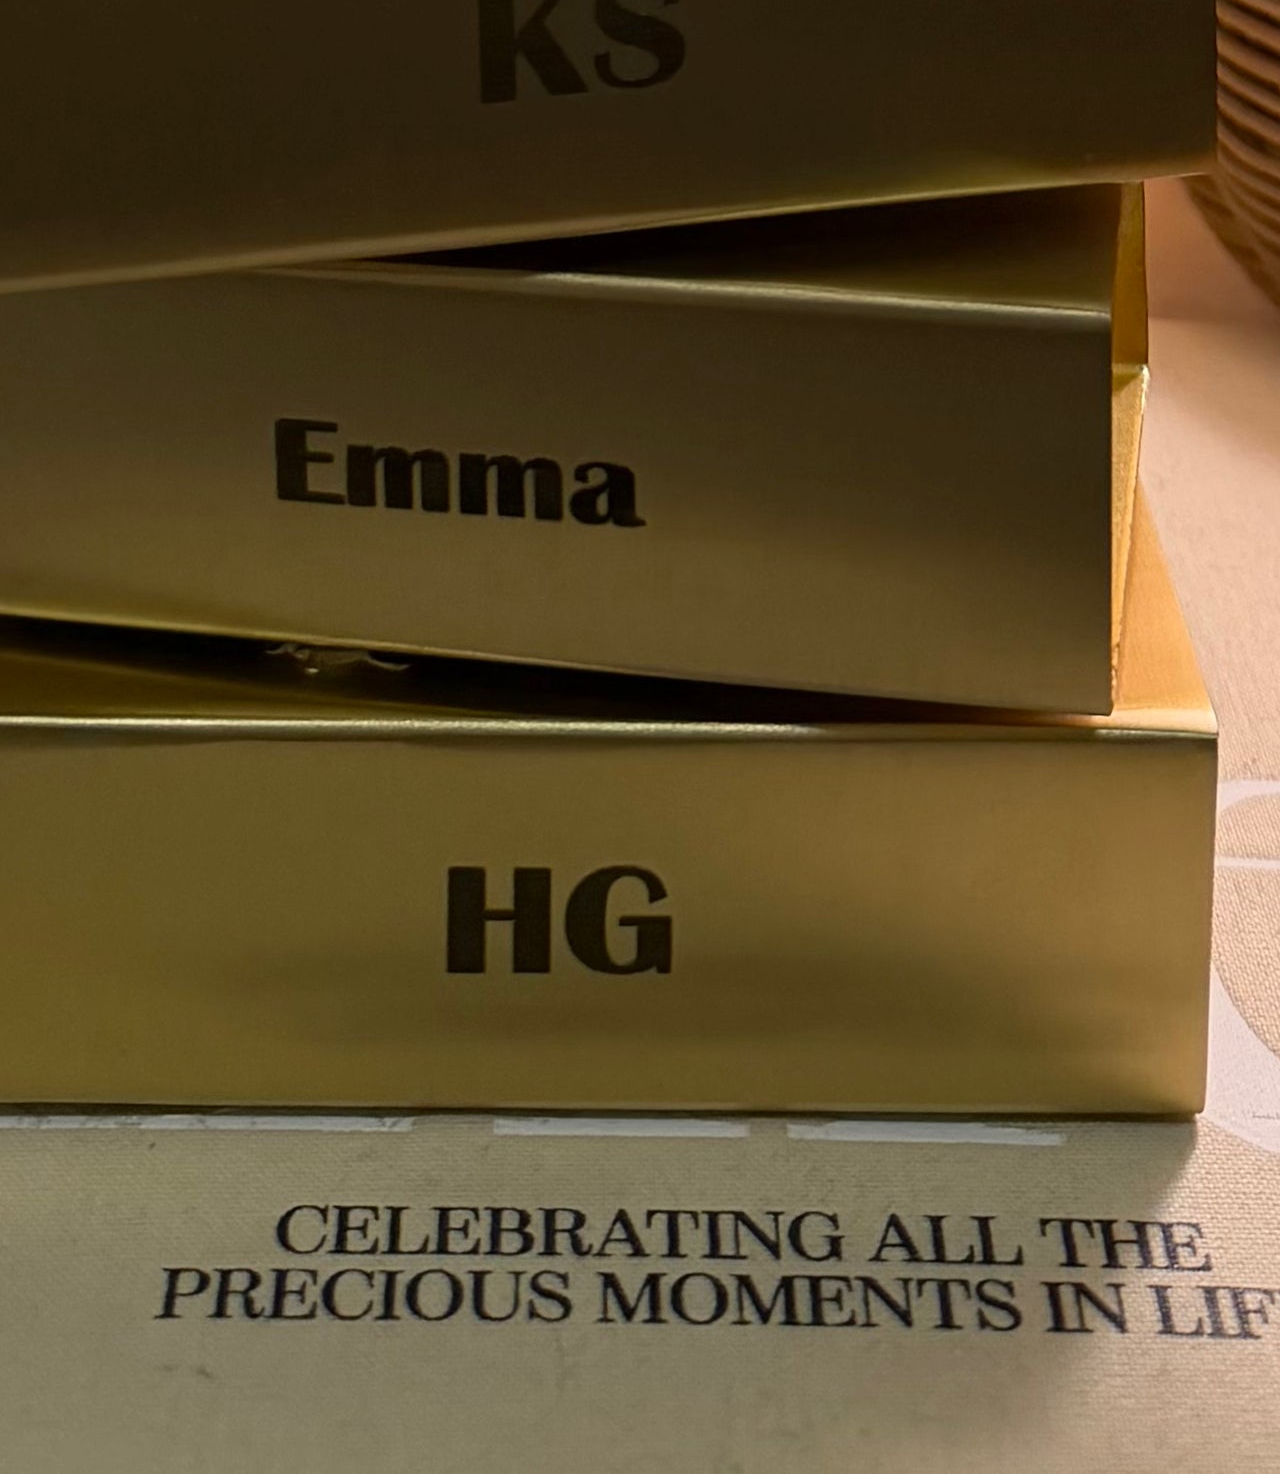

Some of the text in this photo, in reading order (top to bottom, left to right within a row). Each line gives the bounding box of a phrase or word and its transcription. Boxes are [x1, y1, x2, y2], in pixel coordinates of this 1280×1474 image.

[273, 417, 646, 530] Emma
[444, 864, 674, 977] HG
[275, 1203, 1214, 1273] CELEBRATING ALL THE
[152, 1266, 573, 1323] PRECIOUS
[594, 1270, 1024, 1333] MOMENTS
[1040, 1280, 1129, 1335] IN
